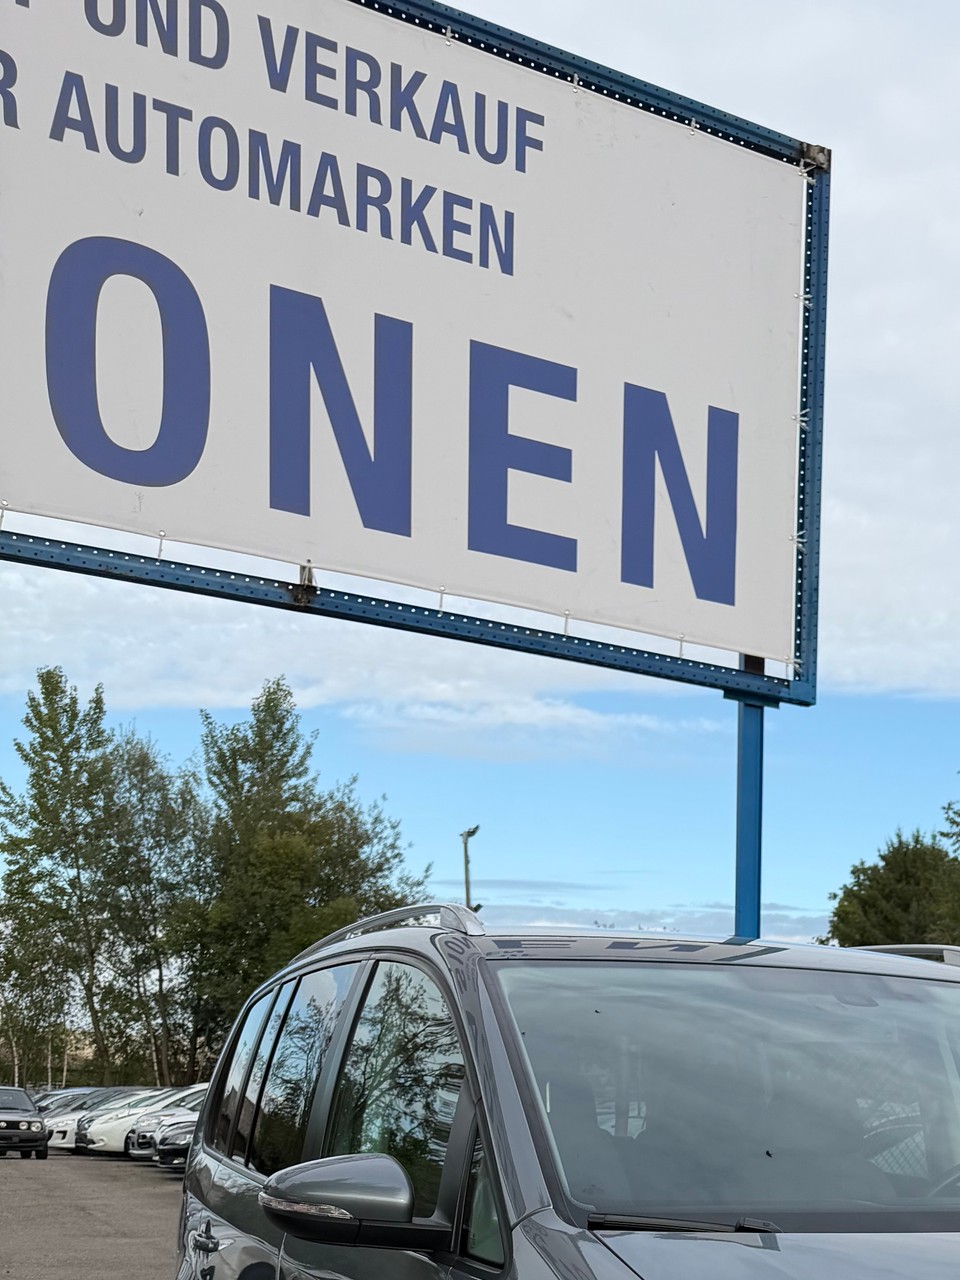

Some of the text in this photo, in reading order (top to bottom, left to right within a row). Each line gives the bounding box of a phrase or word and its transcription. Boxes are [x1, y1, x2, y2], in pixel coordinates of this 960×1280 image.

[49, 70, 515, 277] AUTOMARKEN
[260, 15, 544, 173] VERKAUF
[45, 235, 741, 608] ONEN
